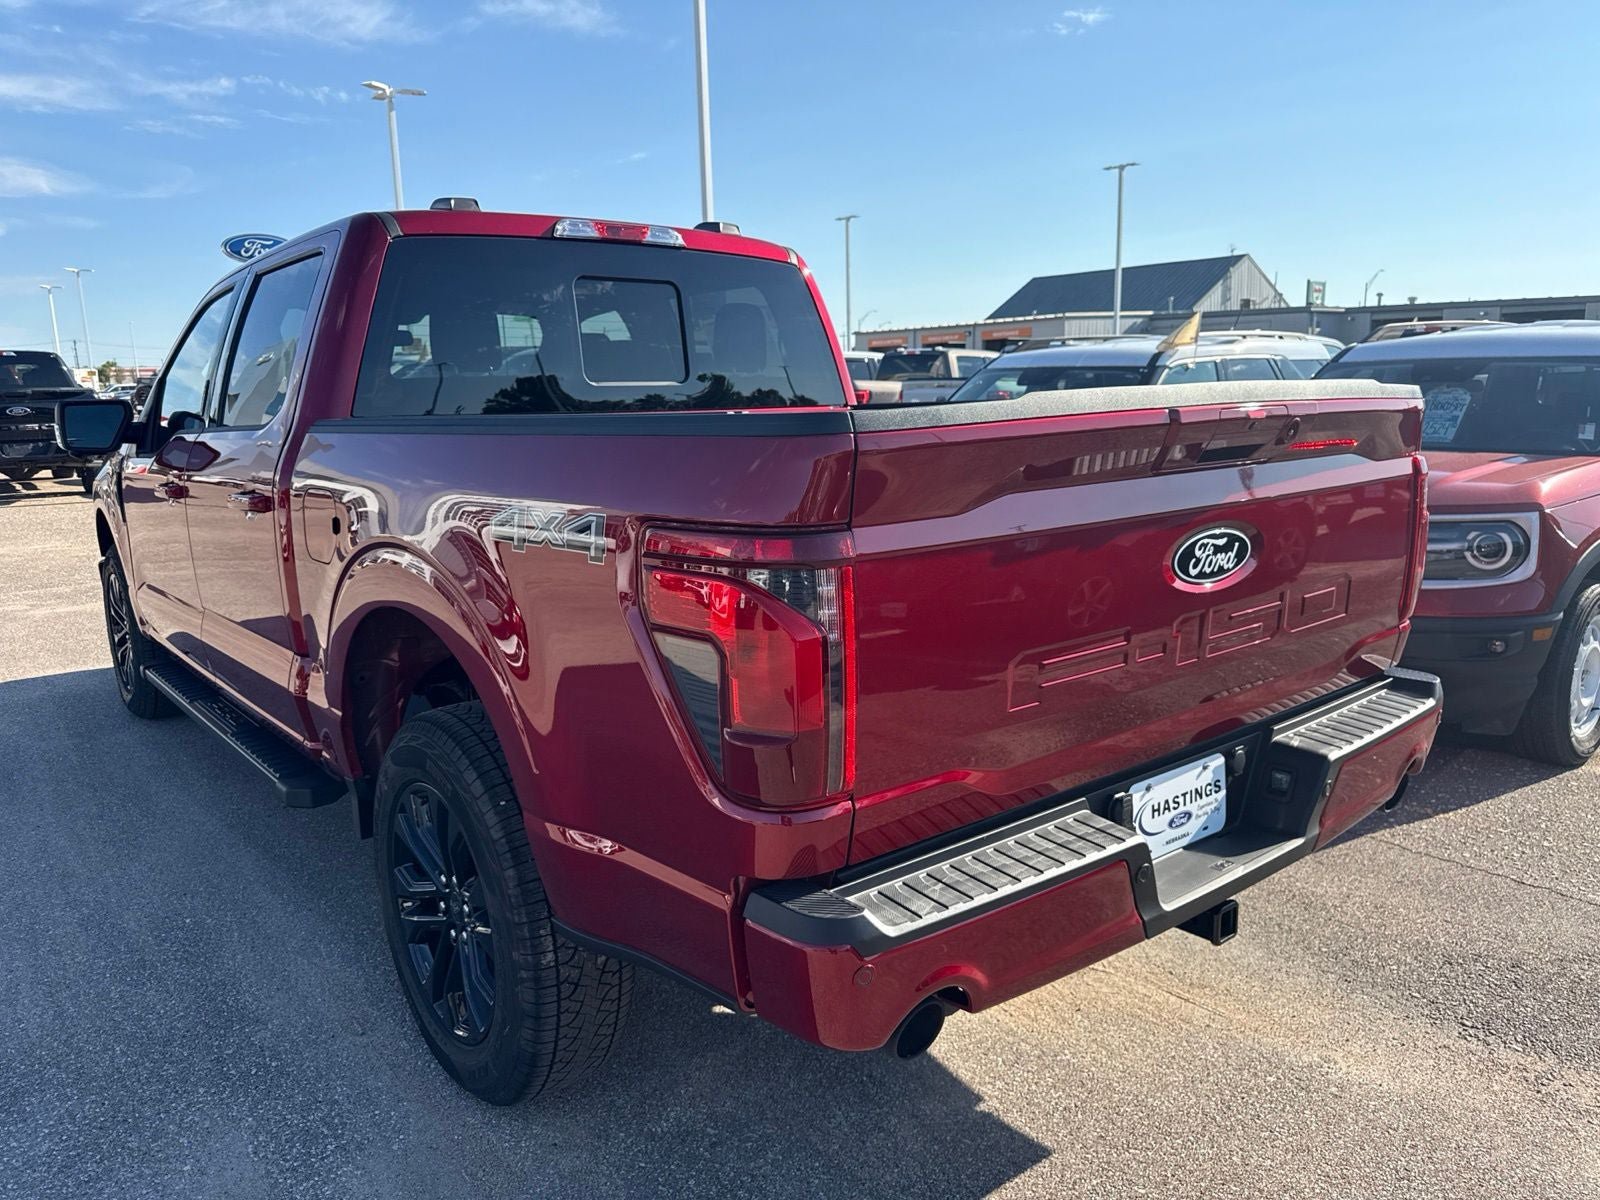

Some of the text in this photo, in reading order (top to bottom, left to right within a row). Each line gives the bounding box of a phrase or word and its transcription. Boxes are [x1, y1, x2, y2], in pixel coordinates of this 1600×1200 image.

[241, 239, 274, 257] Fo
[1188, 537, 1240, 577] Ford
[1007, 573, 1352, 712] F-150
[1151, 779, 1222, 819] HASTINGS
